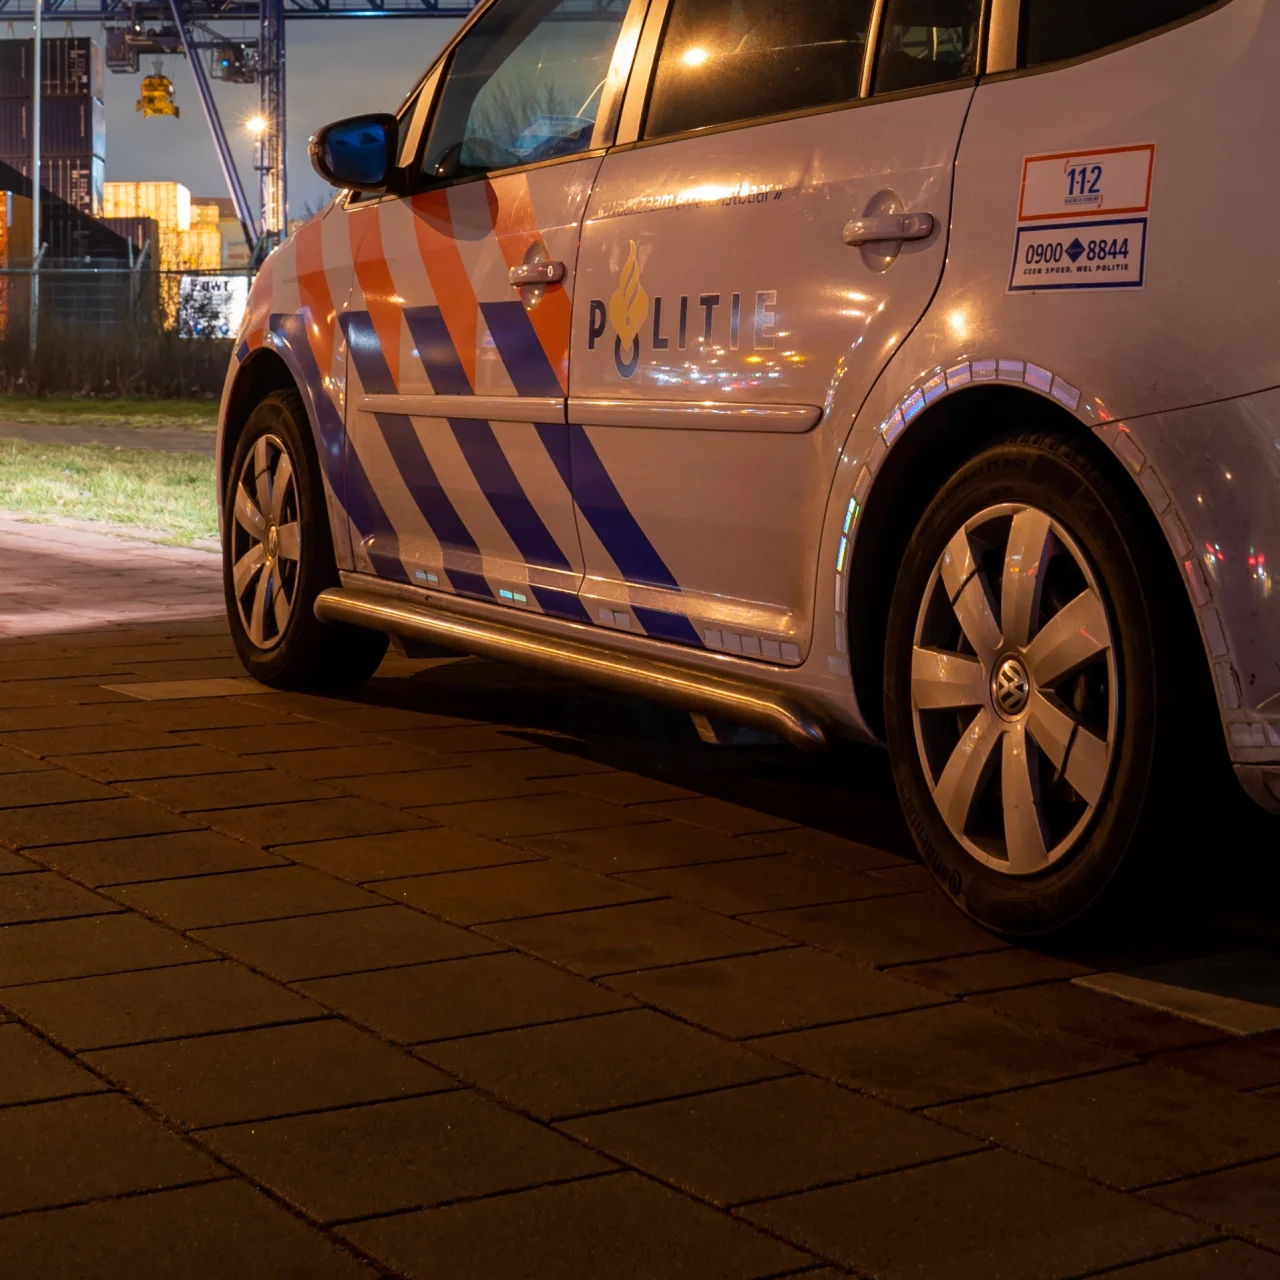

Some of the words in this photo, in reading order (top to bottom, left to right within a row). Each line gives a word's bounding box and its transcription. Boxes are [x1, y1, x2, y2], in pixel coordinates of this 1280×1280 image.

[1025, 242, 1063, 265] 0900
[1086, 238, 1129, 261] 8844
[1096, 263, 1129, 272] POLITIE
[588, 290, 777, 380] POLITIE
